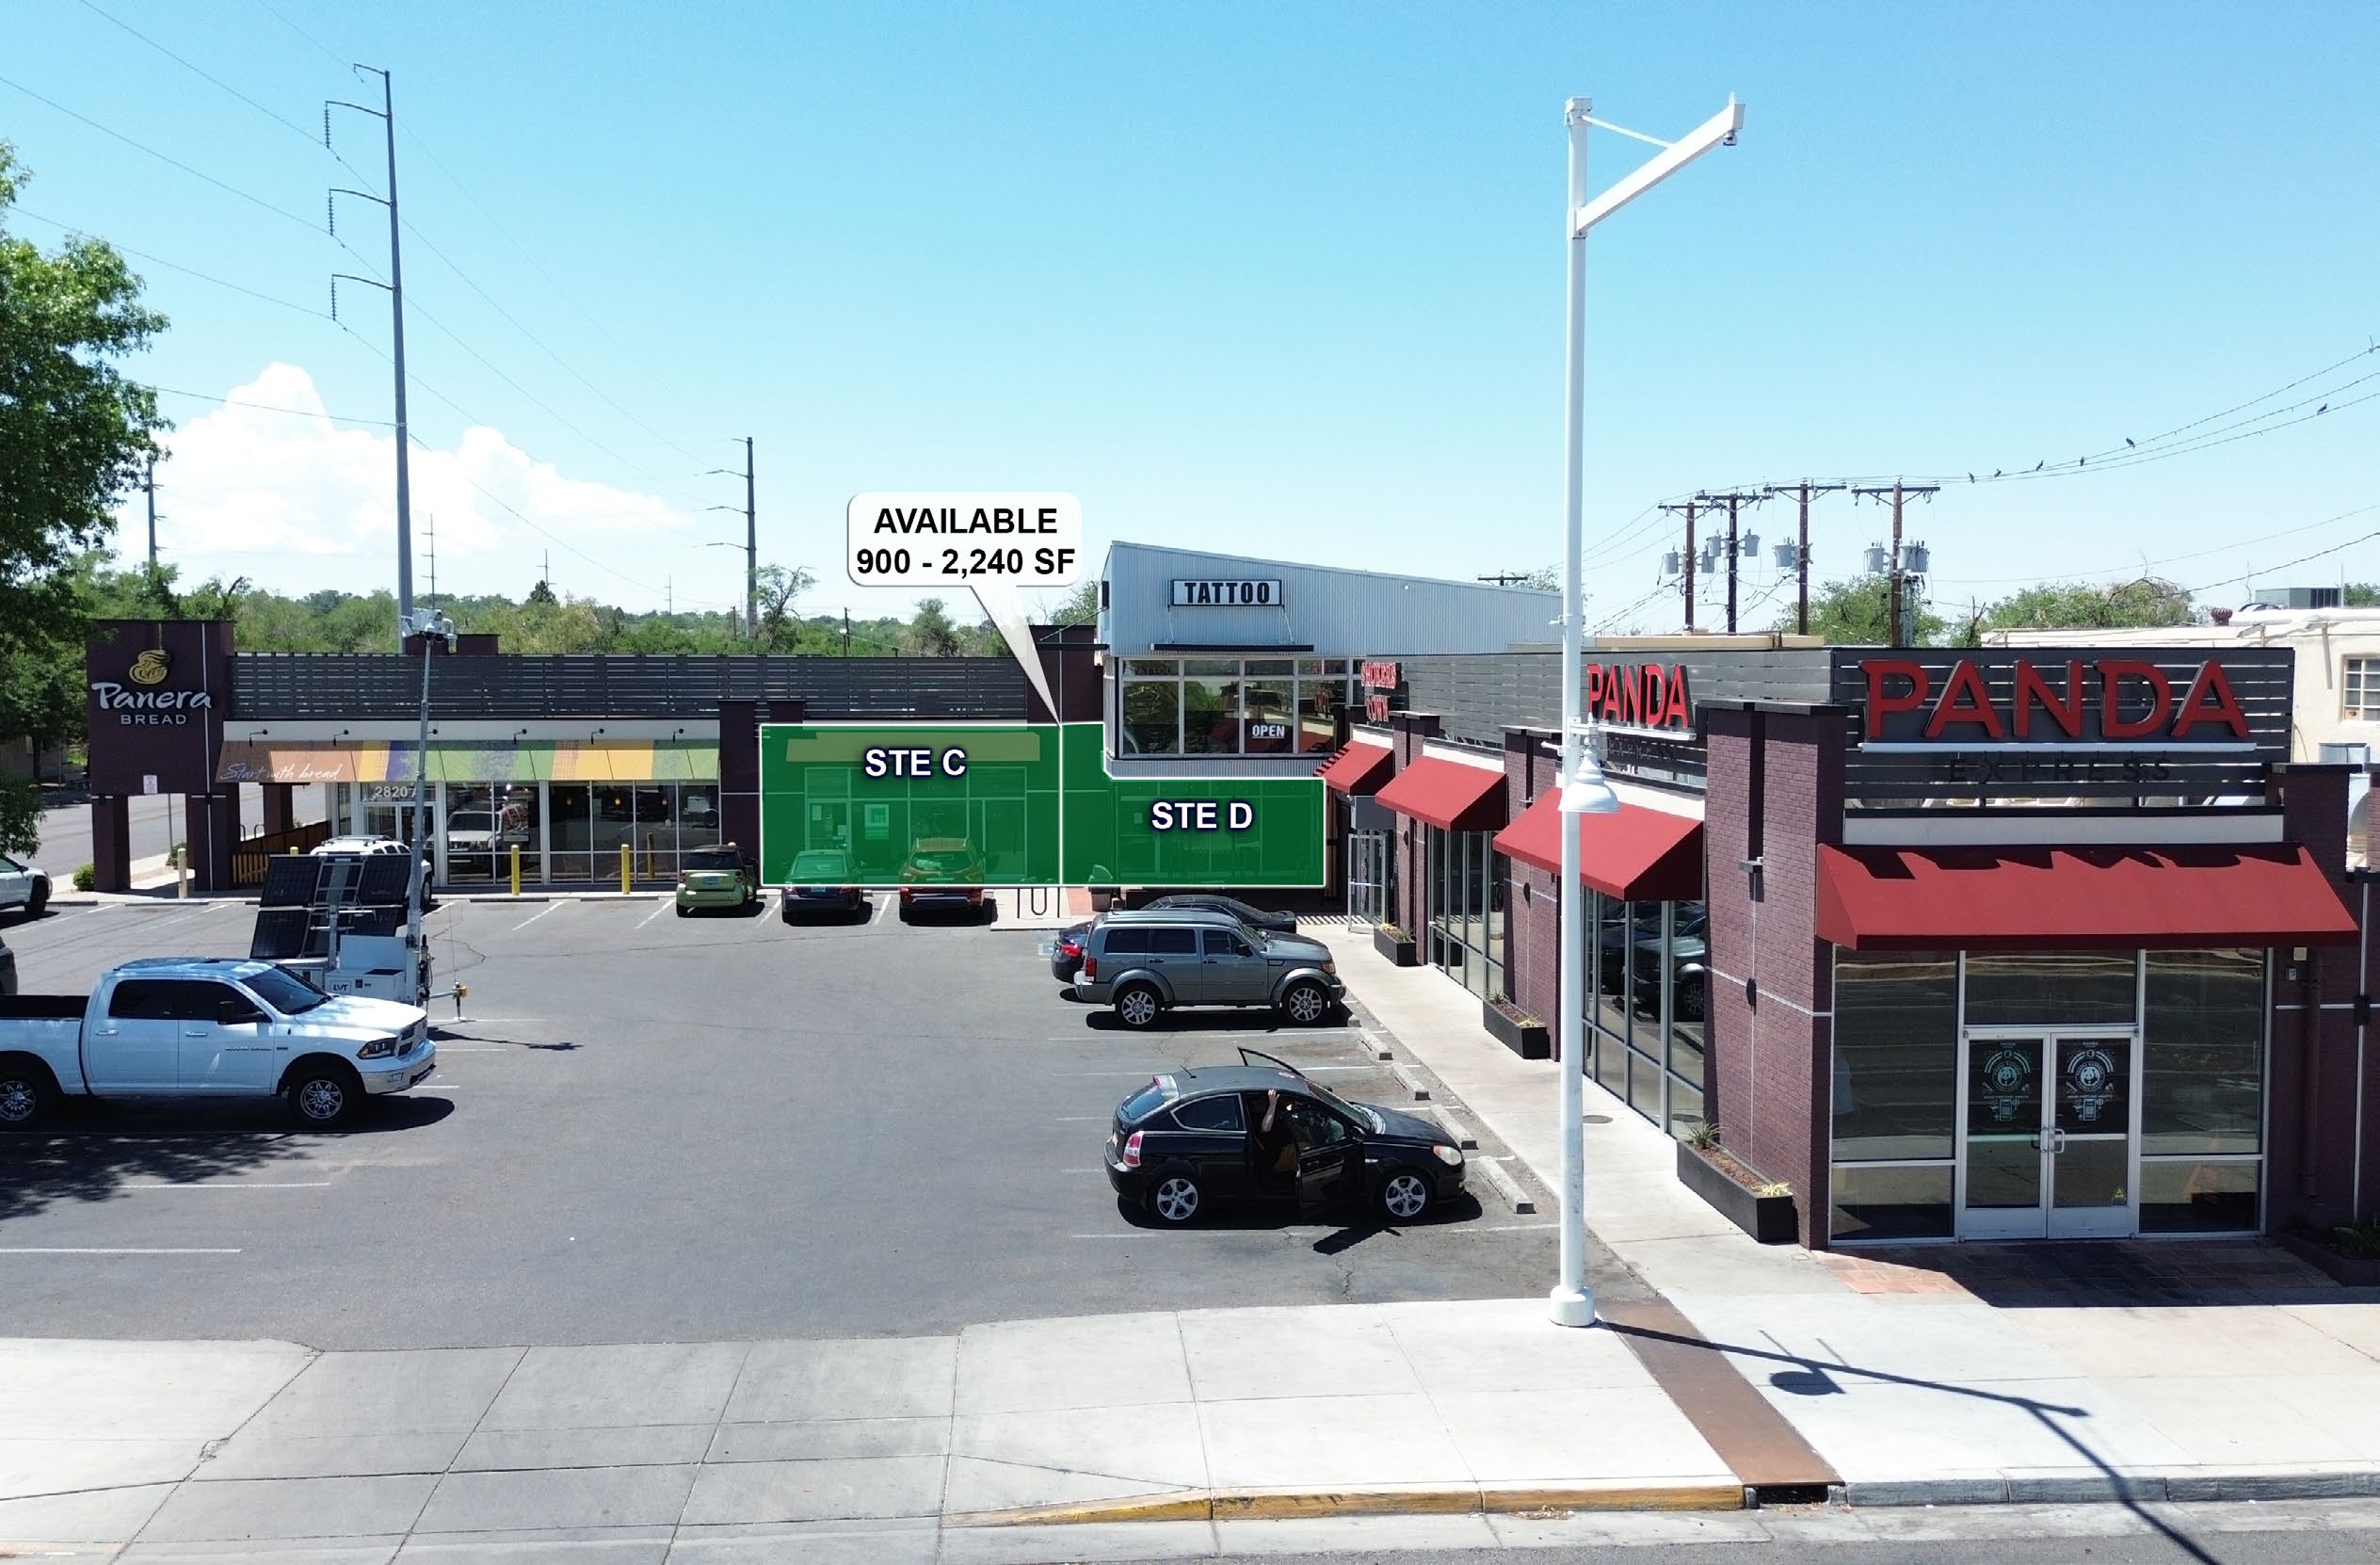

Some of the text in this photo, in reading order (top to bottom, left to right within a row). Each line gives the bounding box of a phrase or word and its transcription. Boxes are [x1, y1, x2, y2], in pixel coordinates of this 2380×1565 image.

[1184, 582, 1270, 604] TATTOO
[90, 682, 212, 709] Panera
[1586, 664, 1694, 729] PANDA
[1857, 658, 2253, 739] PANDA
[121, 714, 187, 725] BREAD
[1252, 724, 1285, 737] OPEN
[219, 762, 344, 781] Start with bread
[1948, 757, 2172, 783] EXPRESS
